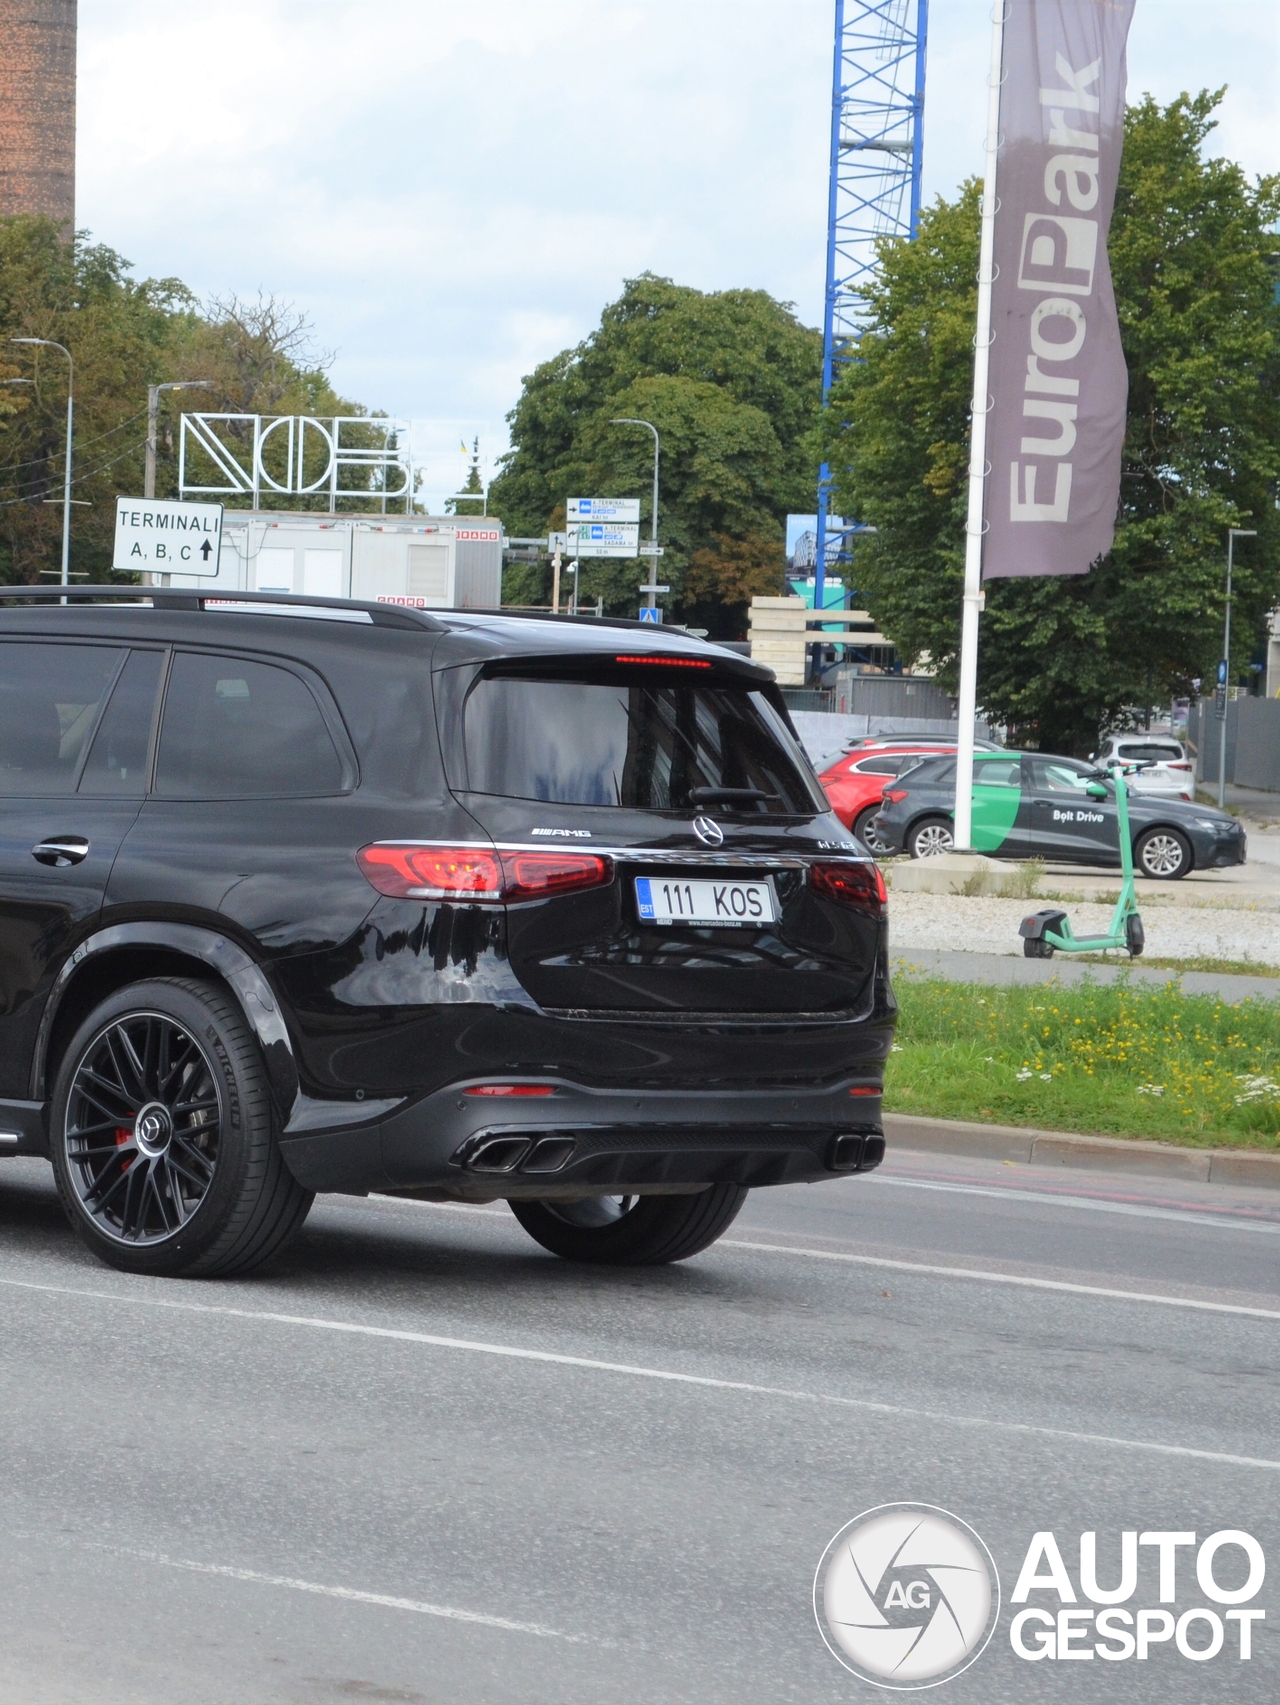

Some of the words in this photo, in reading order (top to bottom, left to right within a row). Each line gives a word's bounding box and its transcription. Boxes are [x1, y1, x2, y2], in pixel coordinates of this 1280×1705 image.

[1010, 50, 1102, 523] EuroPark
[120, 511, 219, 533] TERMINALI
[180, 545, 192, 561] C
[1053, 809, 1074, 824] Bolt
[1076, 810, 1104, 823] Drive
[553, 828, 591, 837] AMG
[641, 904, 655, 914] EST
[663, 884, 695, 915] 111
[714, 886, 762, 917] KOS
[216, 1044, 241, 1126] MICHELIN
